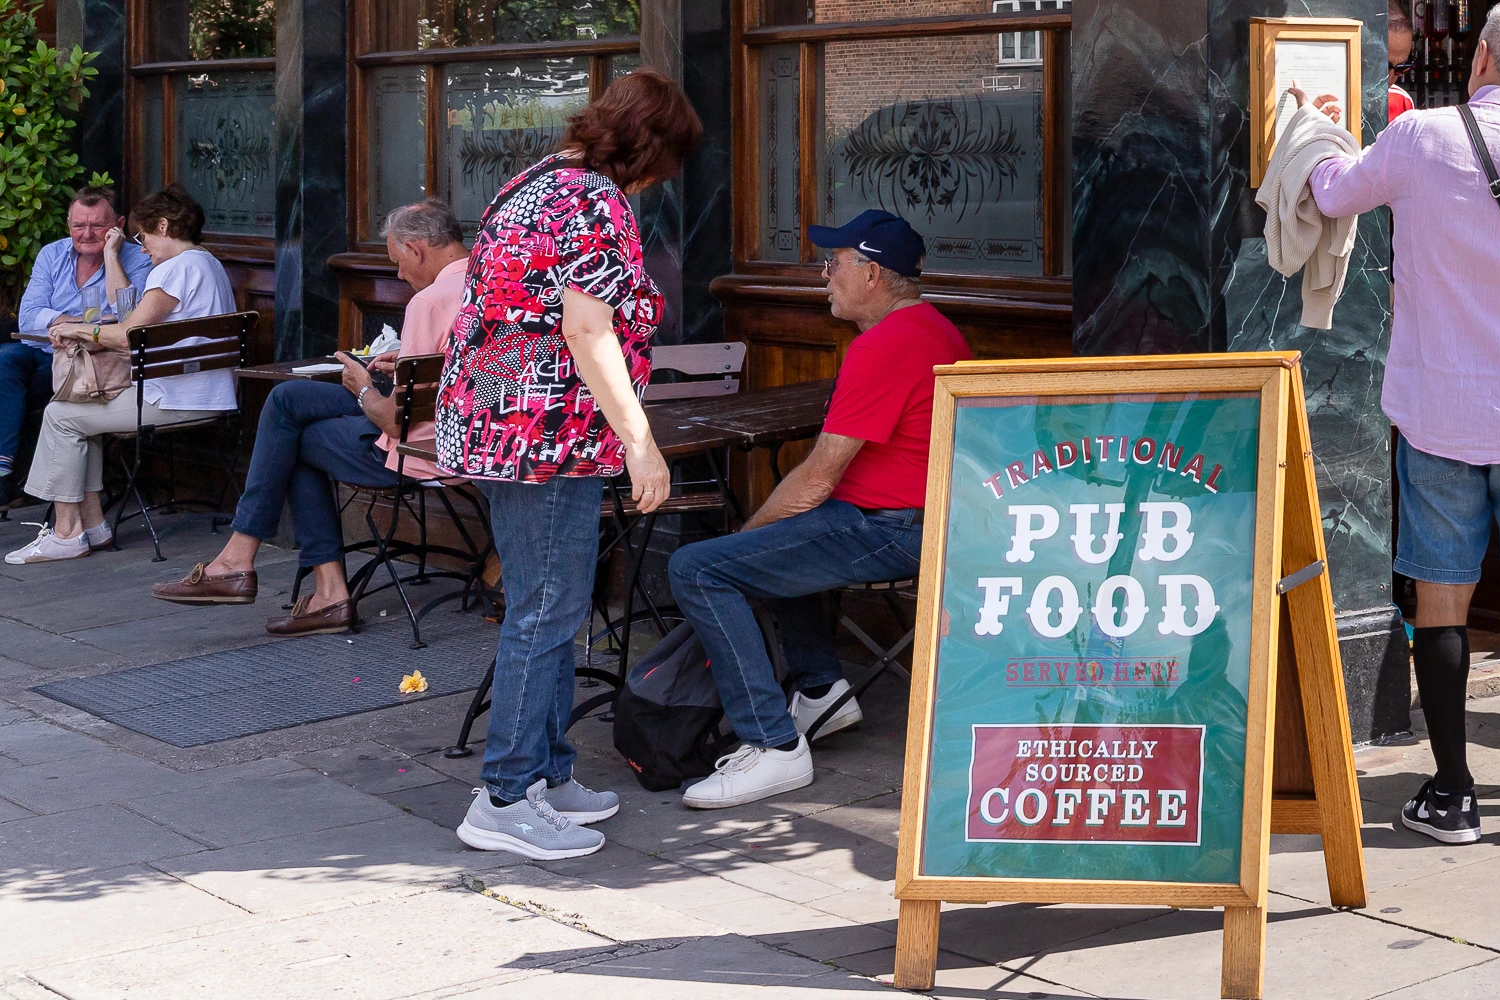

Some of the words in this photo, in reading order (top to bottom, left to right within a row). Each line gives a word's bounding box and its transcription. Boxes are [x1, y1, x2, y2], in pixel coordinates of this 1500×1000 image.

[982, 434, 1224, 500] TRADITIONAL
[1005, 501, 1195, 564] PUB
[974, 574, 1221, 638] FOOD
[1005, 661, 1104, 683] SERVED
[1113, 660, 1180, 682] HERE
[1016, 740, 1158, 759] ETHICALLY
[1025, 764, 1144, 783] SOURCED
[979, 788, 1187, 828] COFFEE
